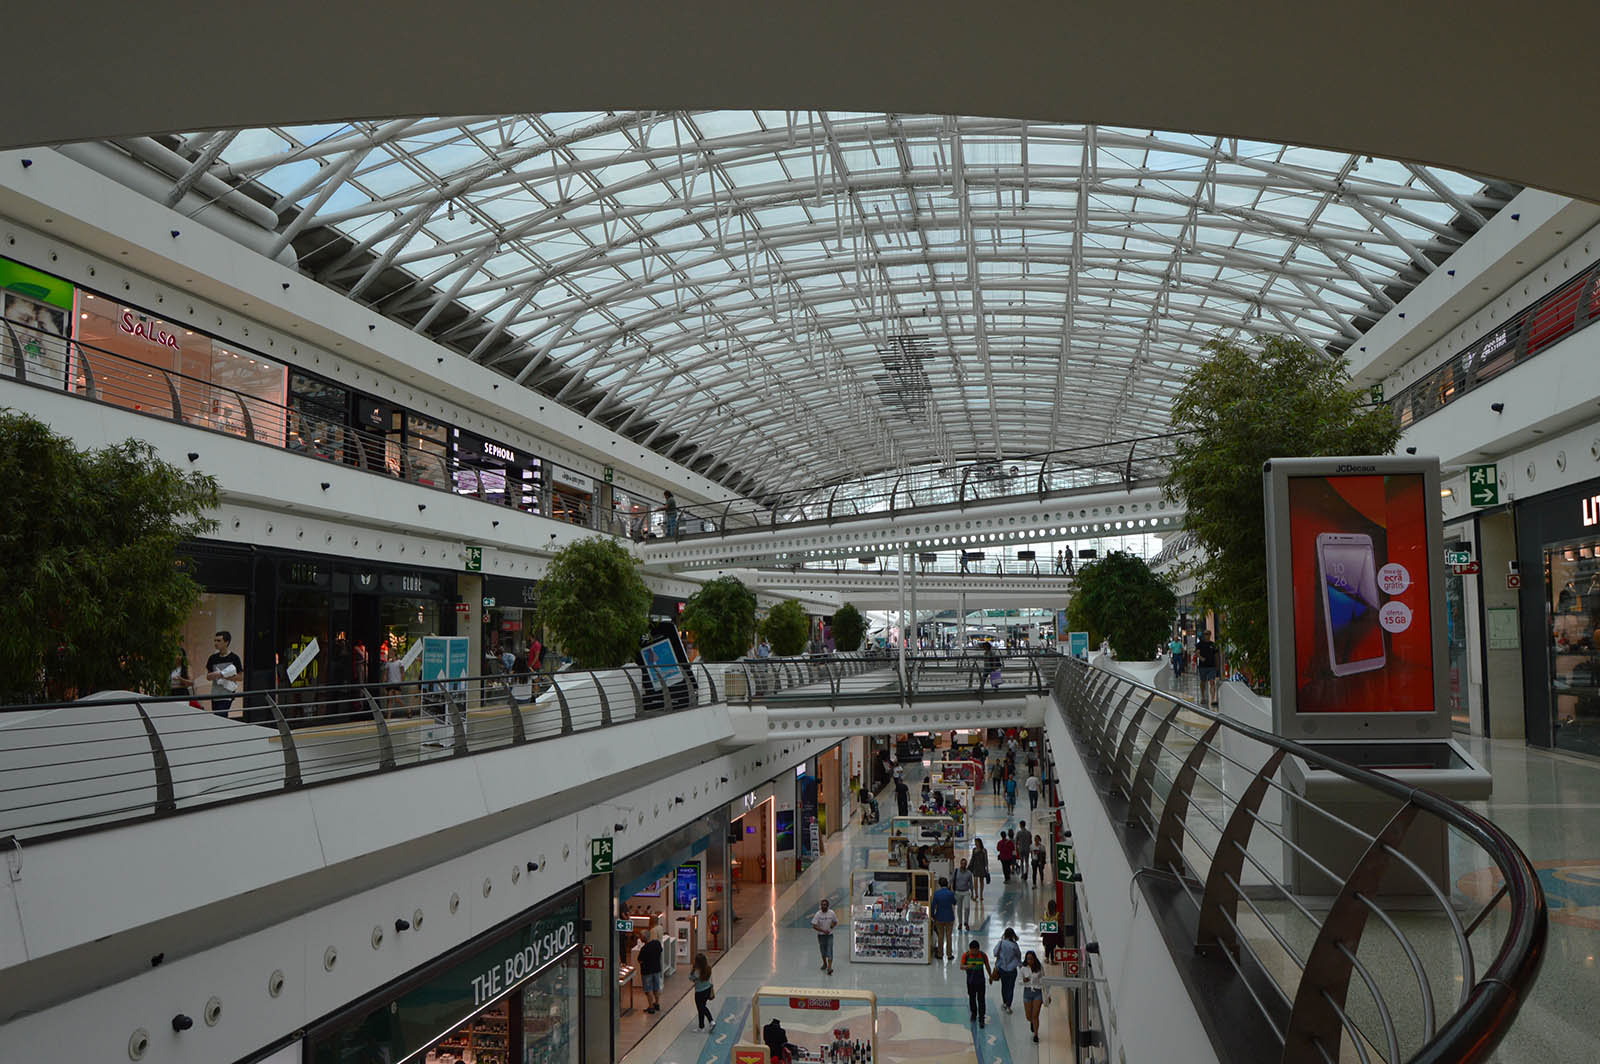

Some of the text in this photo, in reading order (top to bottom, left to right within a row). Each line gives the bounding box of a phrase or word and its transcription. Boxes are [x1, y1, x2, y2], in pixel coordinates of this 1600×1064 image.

[119, 312, 180, 351] Salsa
[484, 441, 515, 463] SEPHORA
[1335, 463, 1376, 473] JCDecaux
[1384, 616, 1407, 625] 15 GB
[471, 965, 502, 1006] THE
[505, 939, 542, 986] BODY
